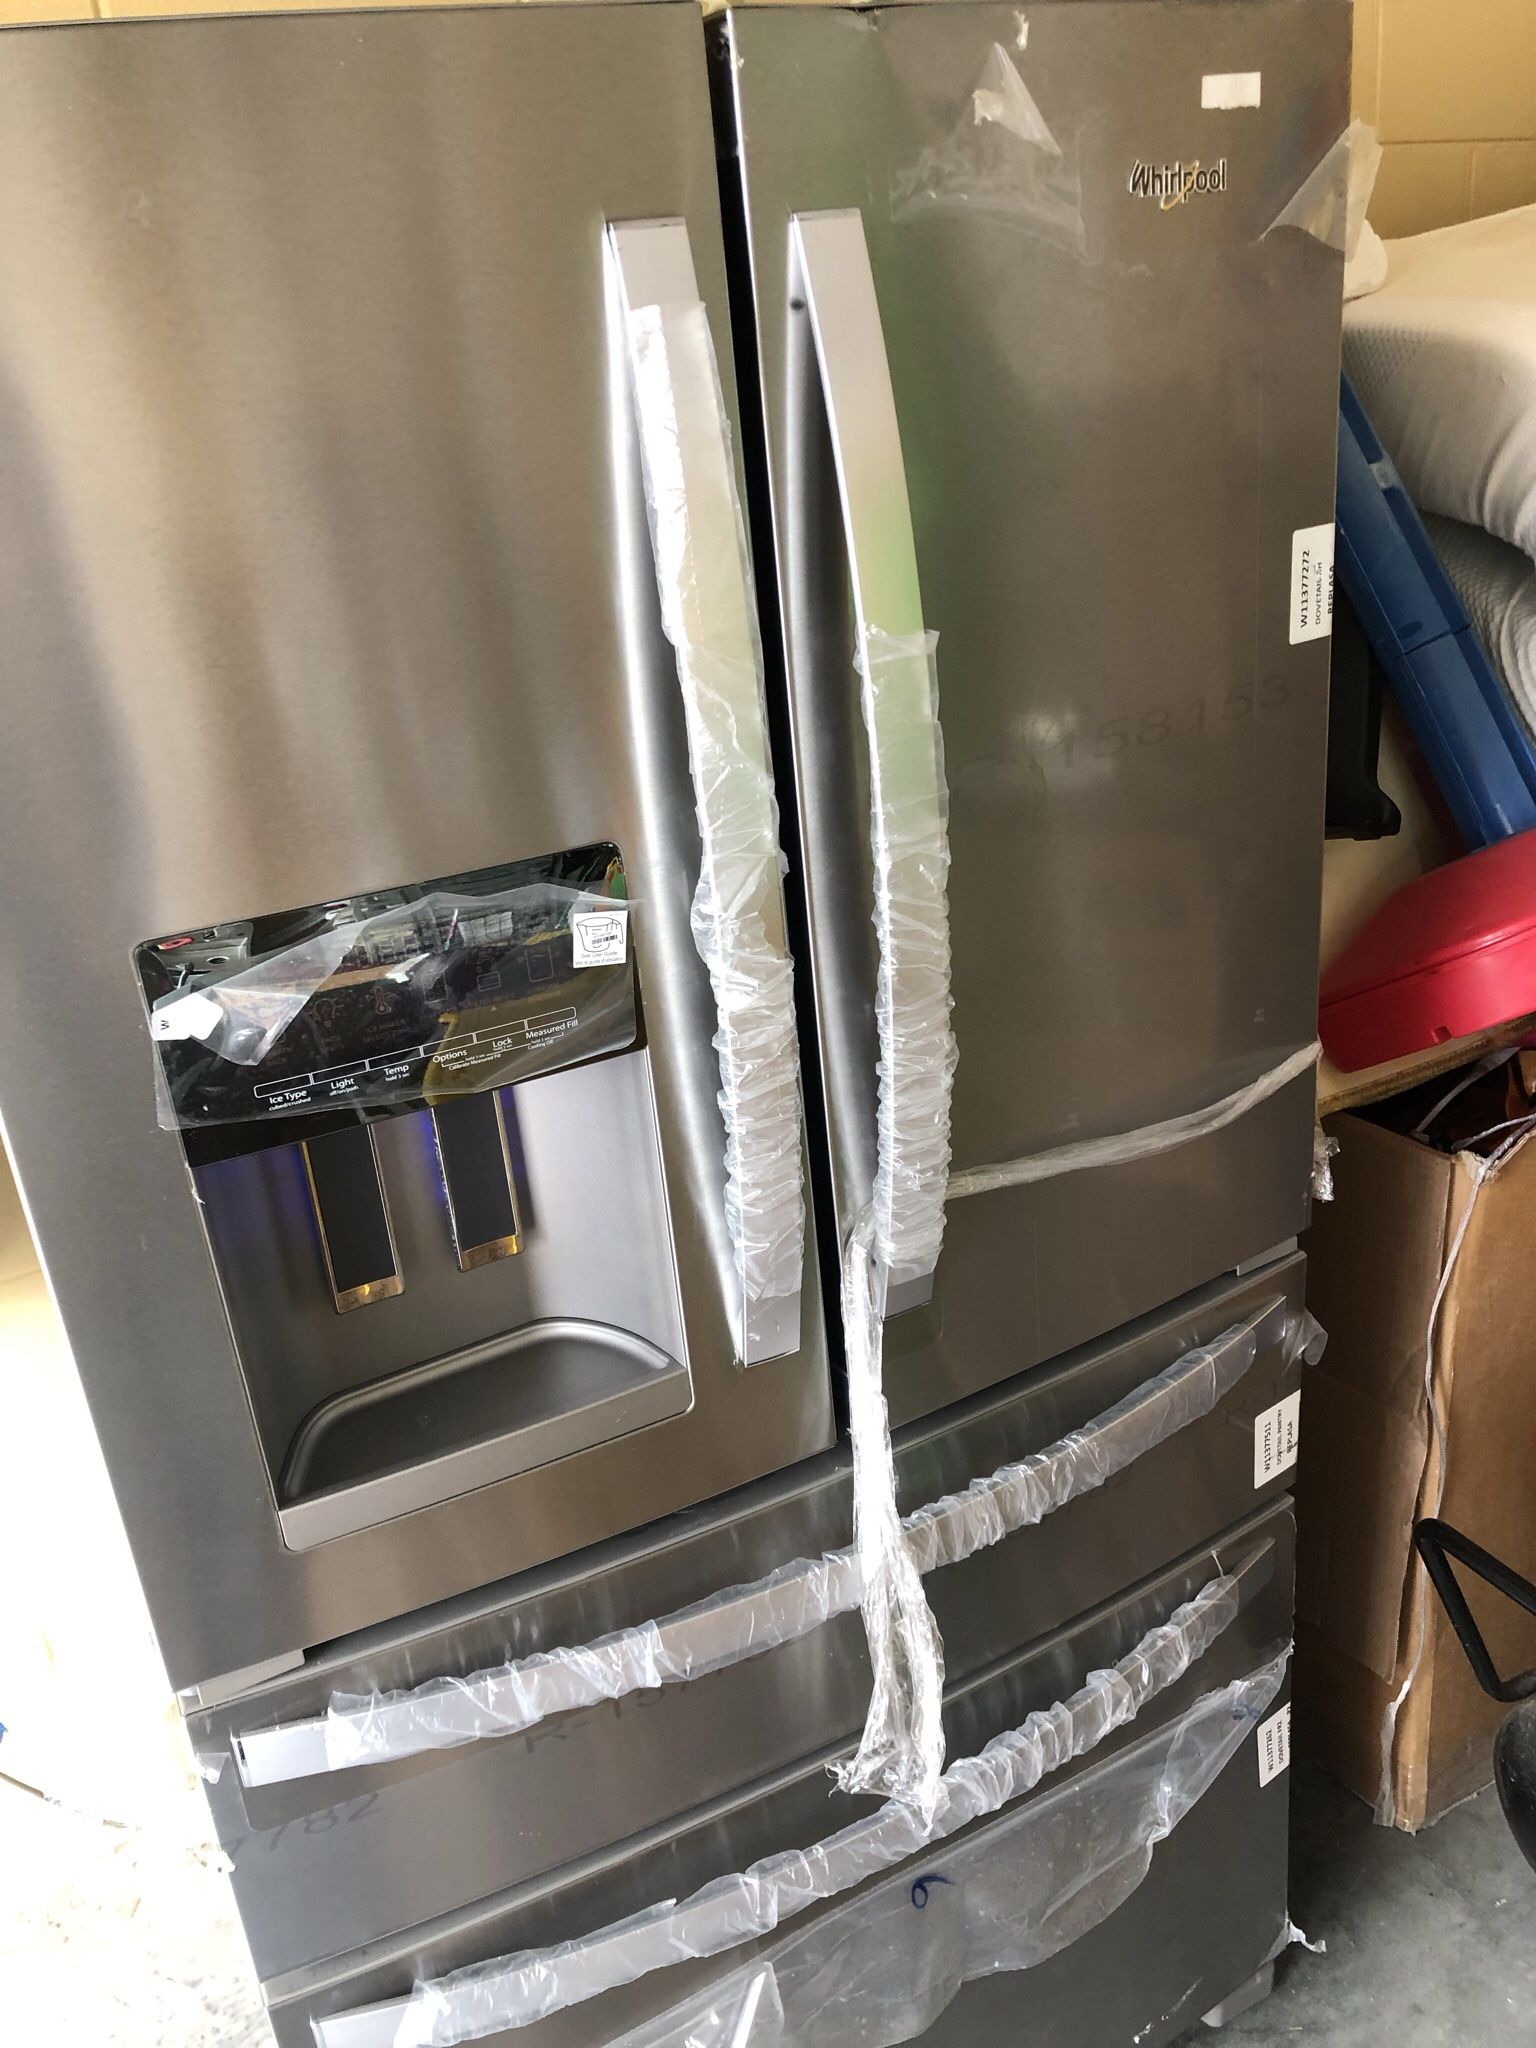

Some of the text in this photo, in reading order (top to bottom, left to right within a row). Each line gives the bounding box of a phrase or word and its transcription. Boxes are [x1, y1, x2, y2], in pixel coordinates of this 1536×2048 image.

[1129, 158, 1227, 210] Whirlpool
[1300, 549, 1310, 628] W11377272
[525, 1018, 578, 1039] Measured Fill
[492, 1037, 512, 1048] Lock
[432, 1049, 467, 1063] Options
[384, 1064, 409, 1076] Temp
[330, 1078, 355, 1090] Light
[269, 1090, 307, 1104] Ice Type
